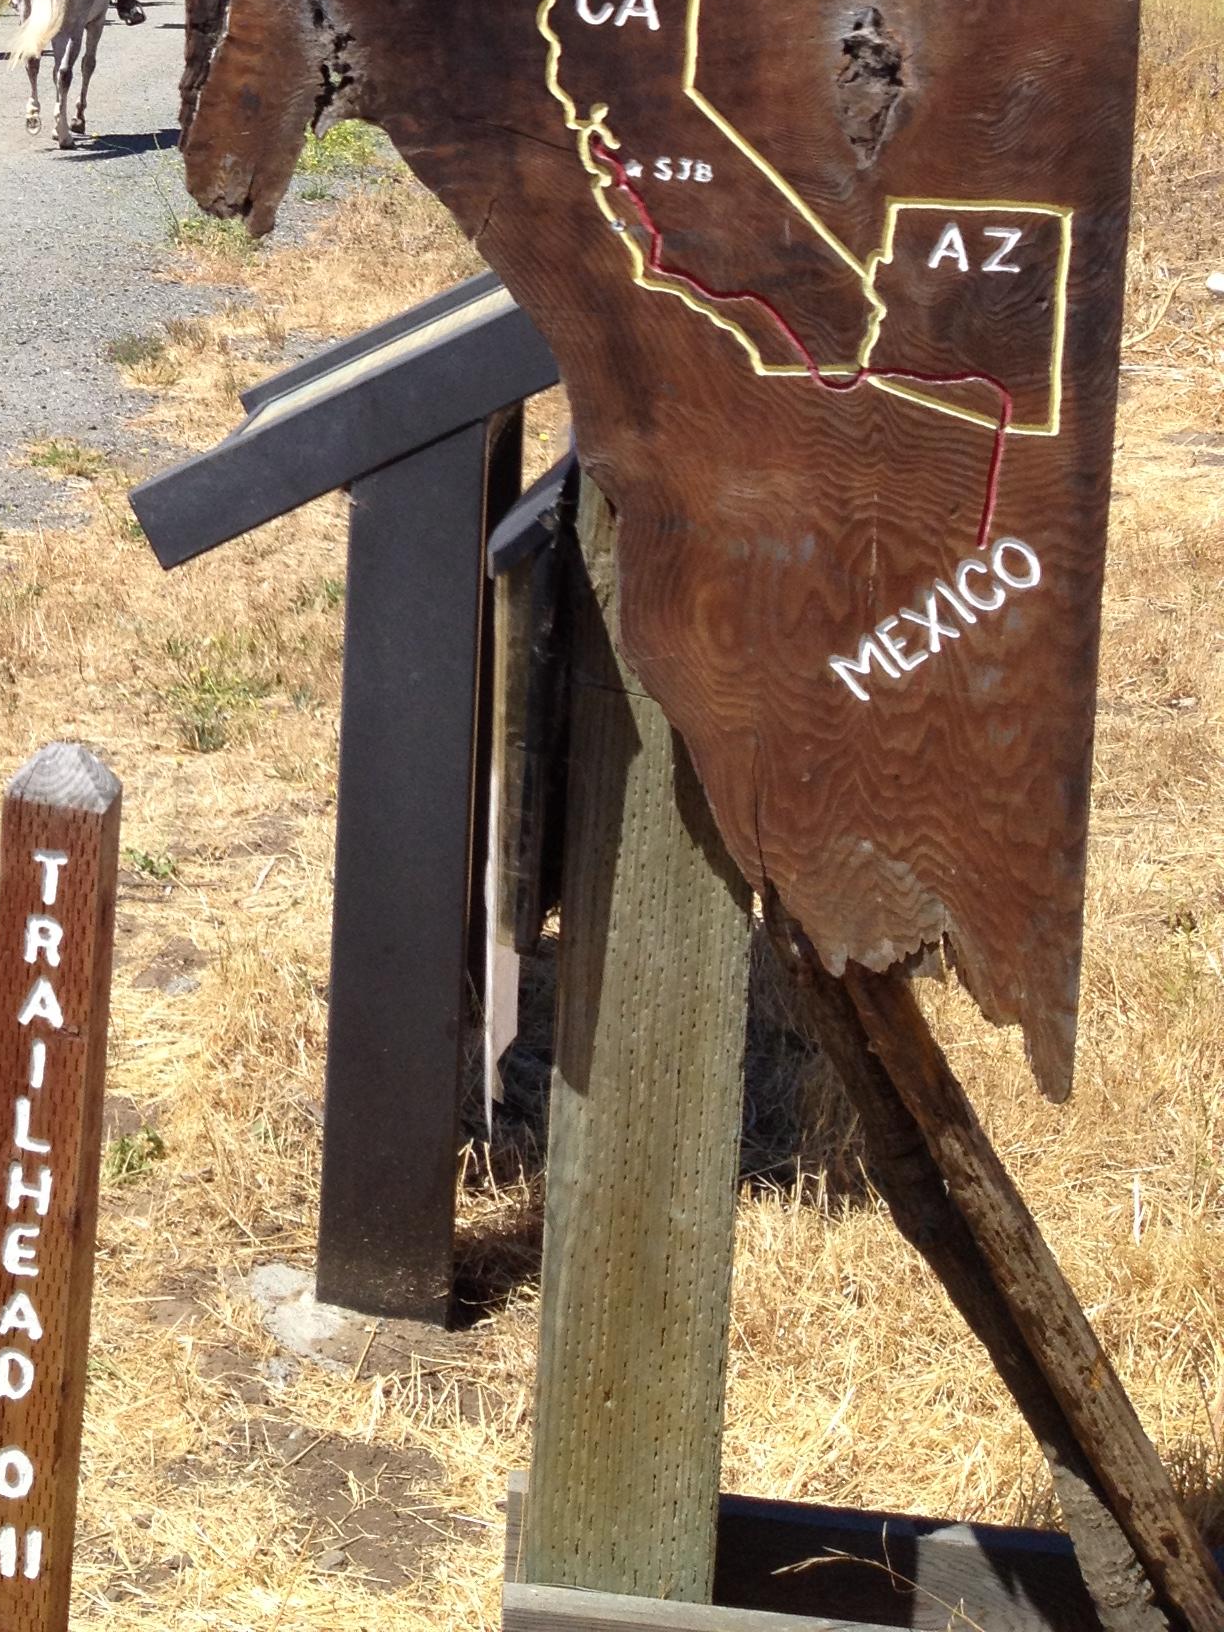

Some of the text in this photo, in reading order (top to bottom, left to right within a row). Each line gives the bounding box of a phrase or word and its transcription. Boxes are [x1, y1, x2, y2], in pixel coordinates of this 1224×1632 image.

[653, 156, 713, 183] SJB
[928, 223, 1023, 272] AZ
[830, 537, 1041, 701] MEXICO
